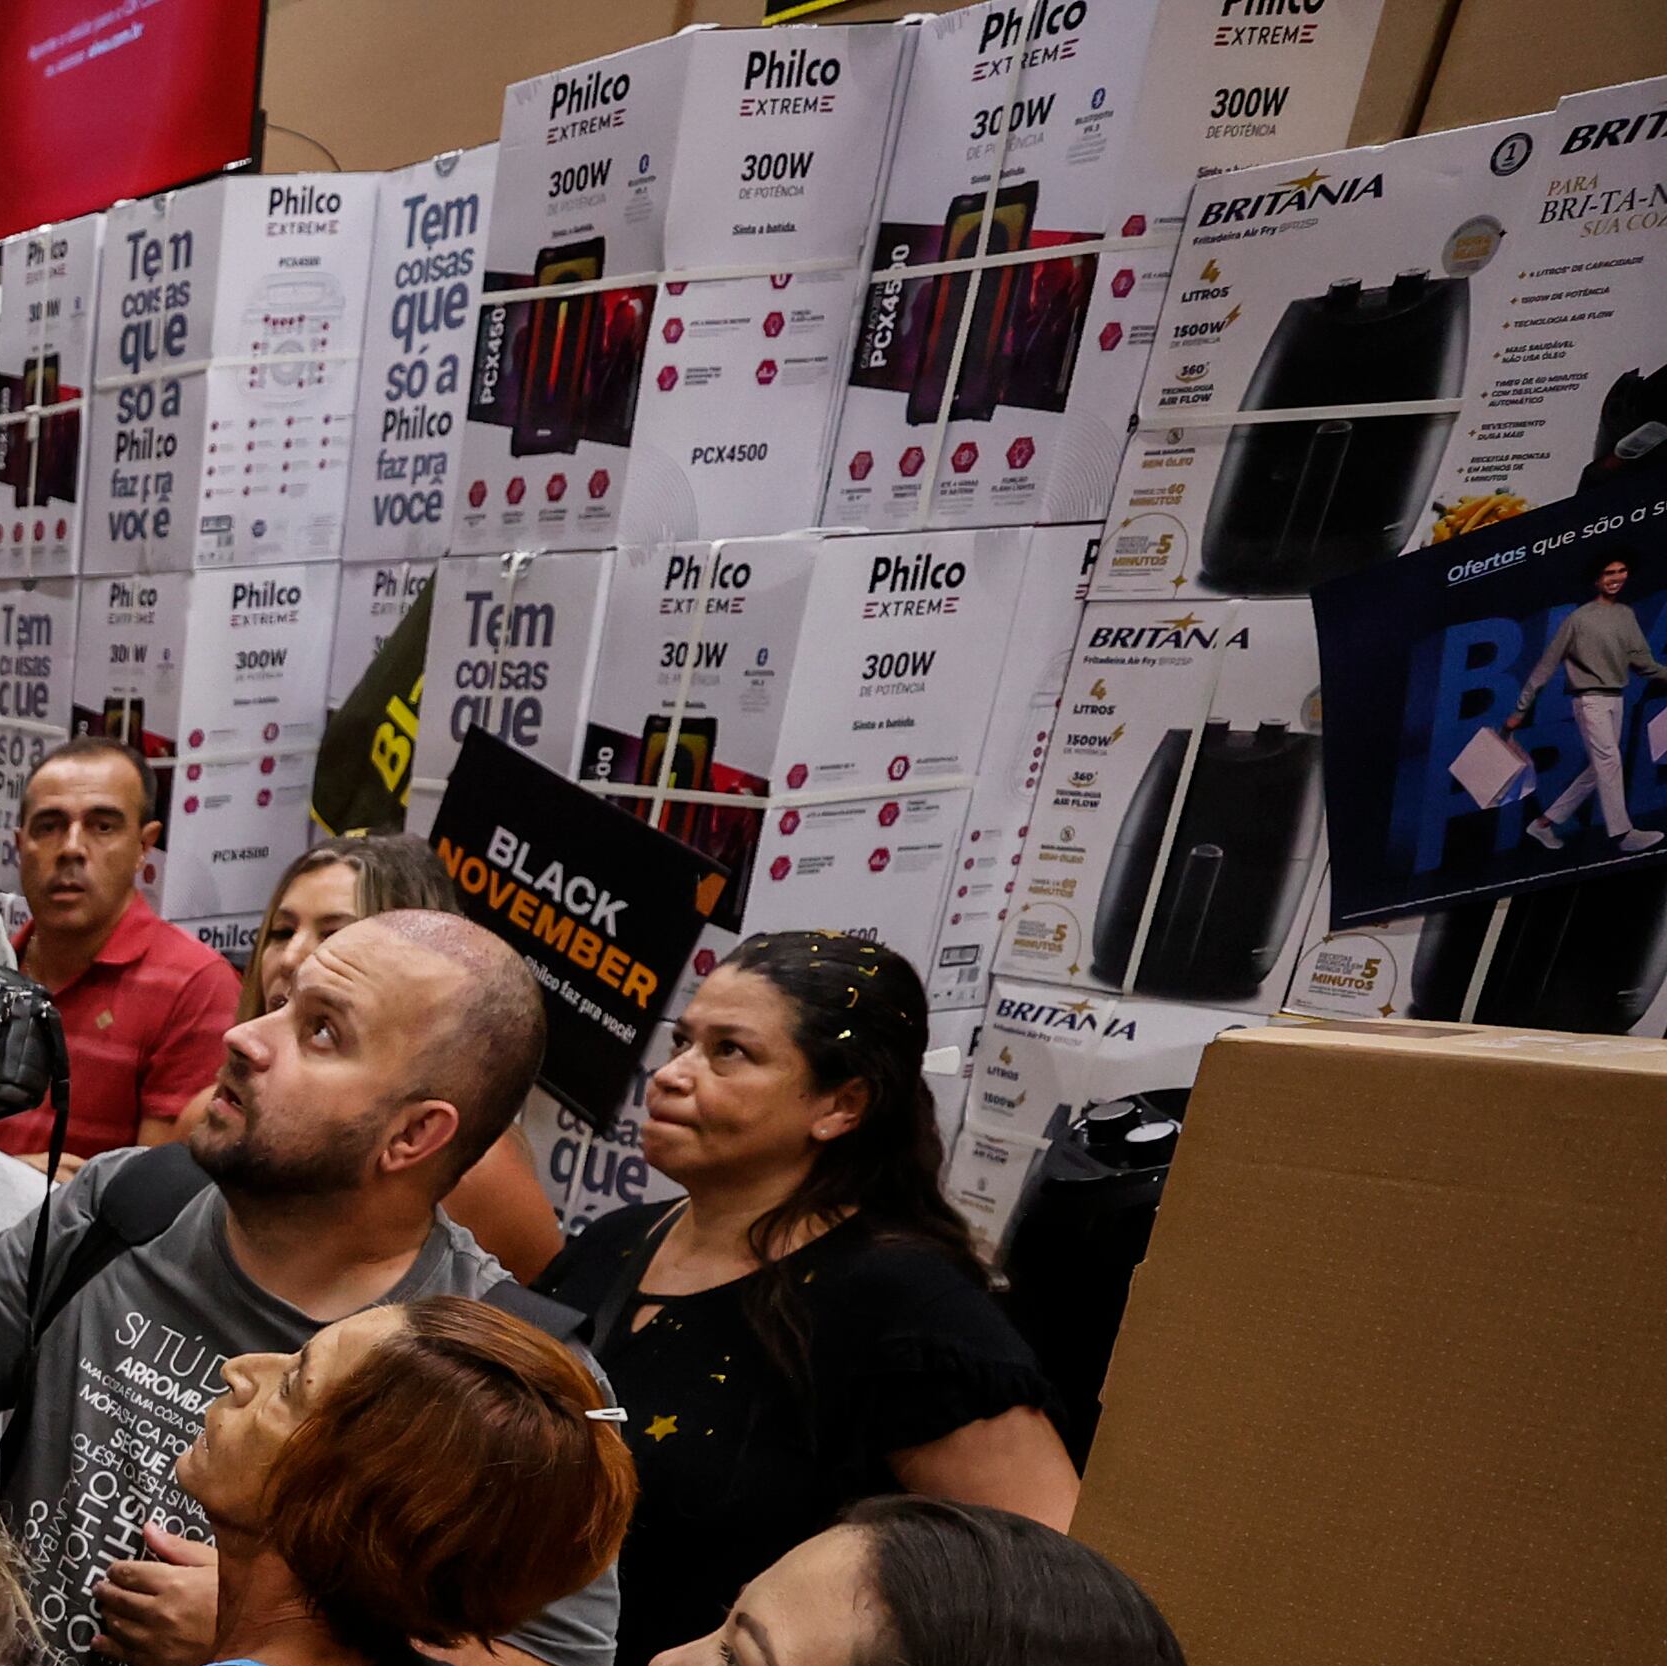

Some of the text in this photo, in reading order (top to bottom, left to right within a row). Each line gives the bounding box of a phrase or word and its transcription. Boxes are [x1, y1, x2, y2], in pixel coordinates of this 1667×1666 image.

[1214, 24, 1318, 46] EXTREME
[744, 48, 841, 91] Philco
[550, 70, 630, 121] Philco
[739, 94, 836, 117] EXTREME
[1210, 86, 1290, 119] 300W
[547, 108, 626, 145] EXTREME
[548, 158, 612, 198] 300W
[740, 151, 814, 182] 300W
[1547, 173, 1598, 196] PARA
[268, 186, 342, 218] Philco
[403, 193, 479, 249] Tem
[1243, 227, 1258, 239] Air
[1259, 225, 1278, 237] Fry
[1580, 217, 1620, 238] SUA
[396, 245, 475, 288] coisas
[869, 244, 910, 369] PCX450
[1181, 286, 1232, 303] LITROS
[391, 282, 470, 354] que
[1173, 319, 1225, 339] 1500W
[385, 343, 460, 401] só a
[480, 302, 507, 406] PCX450
[382, 407, 453, 443] Philco
[377, 449, 448, 485] faz pra
[691, 443, 768, 465] PCX4500
[373, 476, 444, 526] você
[1446, 506, 1647, 584] Ofertas que são a
[664, 553, 751, 591] Phlco
[868, 553, 966, 593] Philco
[232, 579, 301, 610] Philco
[660, 597, 745, 614] EXTEME
[863, 597, 959, 619] EXTREME
[465, 590, 555, 648] Tem
[1088, 626, 1250, 650] BRITANA
[234, 649, 287, 671] 300W
[456, 649, 549, 690] coisas
[862, 650, 937, 680] 300W
[1089, 677, 1107, 701] 4
[1072, 703, 1117, 716] LITROS
[1067, 732, 1113, 748] 1500W
[486, 825, 628, 937] BLACK
[437, 836, 658, 1009] NOVEMBER
[1053, 924, 1068, 942] 5
[1311, 972, 1375, 991] MINUTOS
[1360, 958, 1382, 979] 5
[559, 980, 582, 1008] faz
[581, 995, 603, 1023] pra
[550, 1136, 649, 1205] que
[115, 1312, 206, 1377] SI TÚ
[79, 1357, 102, 1381] UMA
[130, 1392, 155, 1412] UMA
[154, 1406, 184, 1430] COZA
[136, 1419, 162, 1444] CA
[110, 1427, 171, 1475] SEGUE
